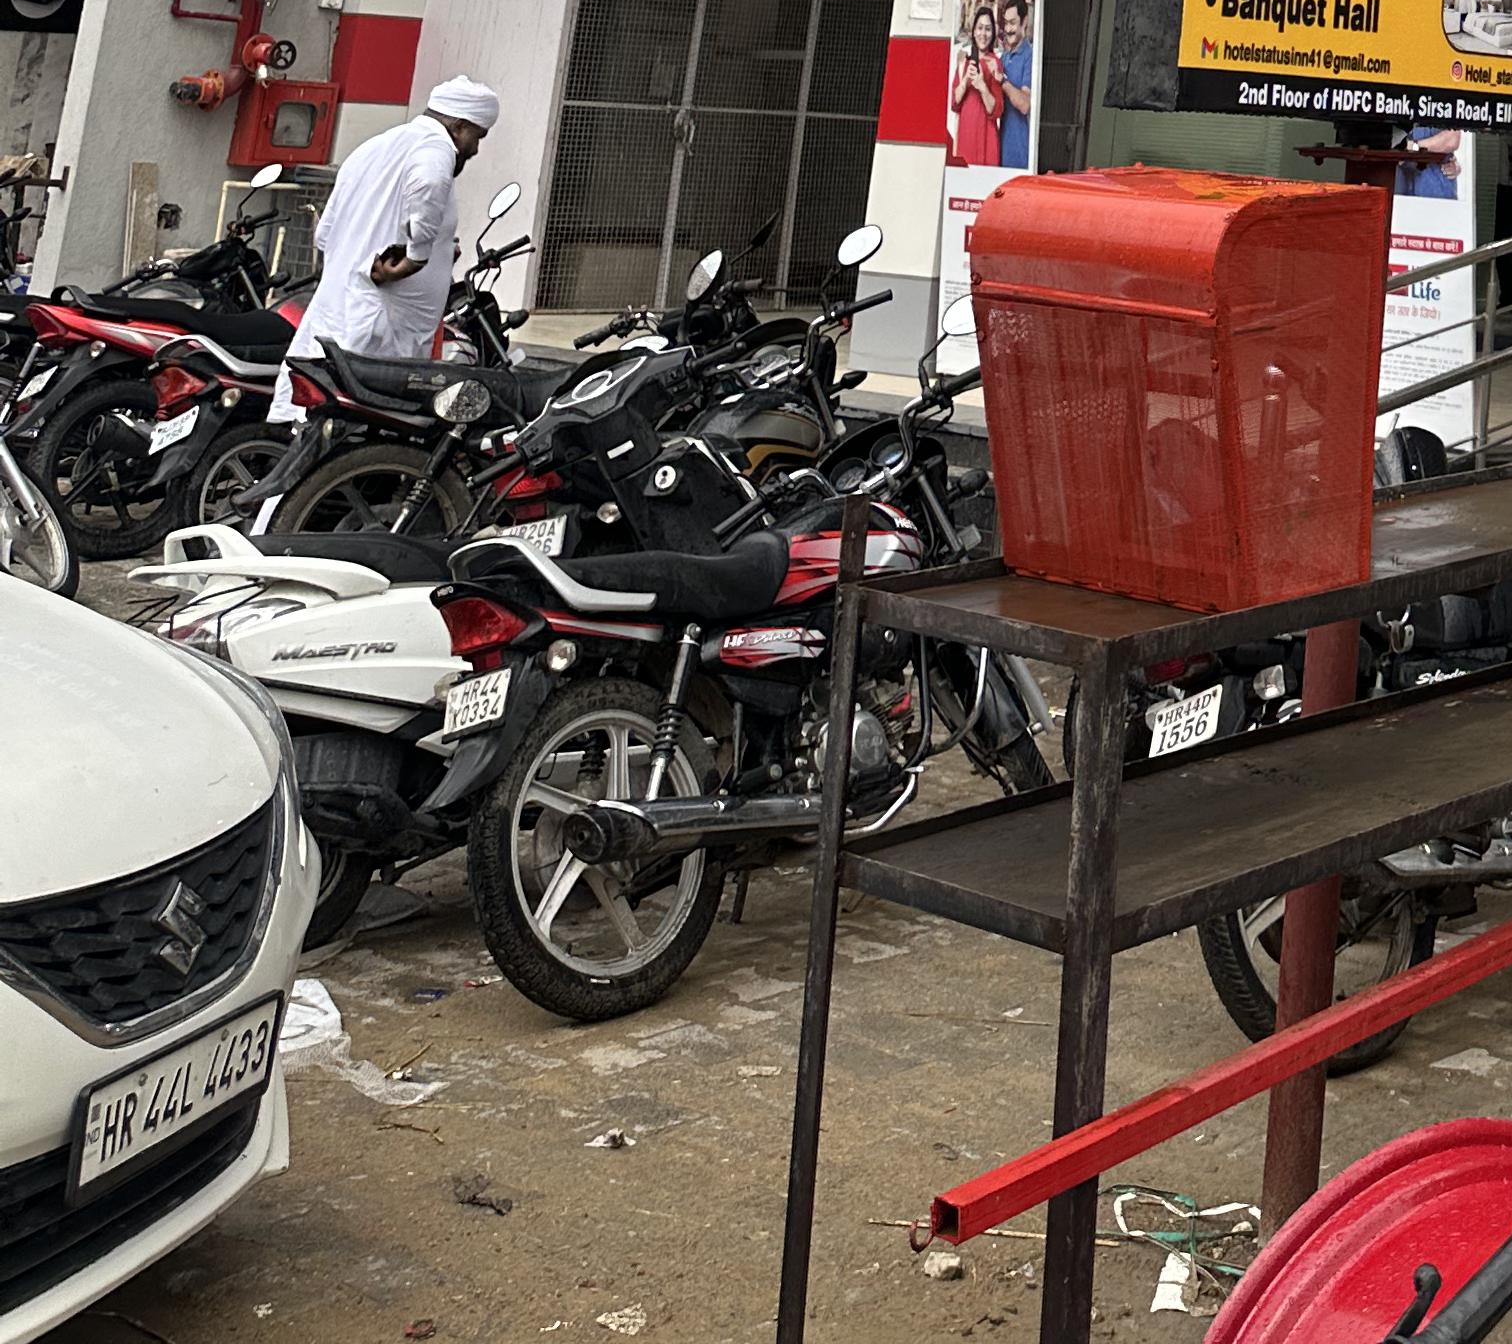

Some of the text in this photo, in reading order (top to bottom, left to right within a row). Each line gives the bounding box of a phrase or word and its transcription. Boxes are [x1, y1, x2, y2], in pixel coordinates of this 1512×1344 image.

[1223, 39, 1391, 76] hotelstatusinn41@gmail.com
[1238, 81, 1269, 106] 2nd
[1271, 84, 1311, 112] Floor
[1313, 87, 1329, 110] of
[1331, 88, 1373, 114] HDFC
[1375, 91, 1415, 119] Bank,
[1418, 95, 1453, 120] Sirsa
[1455, 98, 1493, 125] Road,
[1411, 281, 1441, 301] Life
[723, 633, 748, 648] HF
[460, 672, 502, 705] HR44
[1163, 693, 1212, 728] HR44D
[1156, 711, 1209, 755] 1556
[100, 1019, 270, 1163] HR 44L 4433
